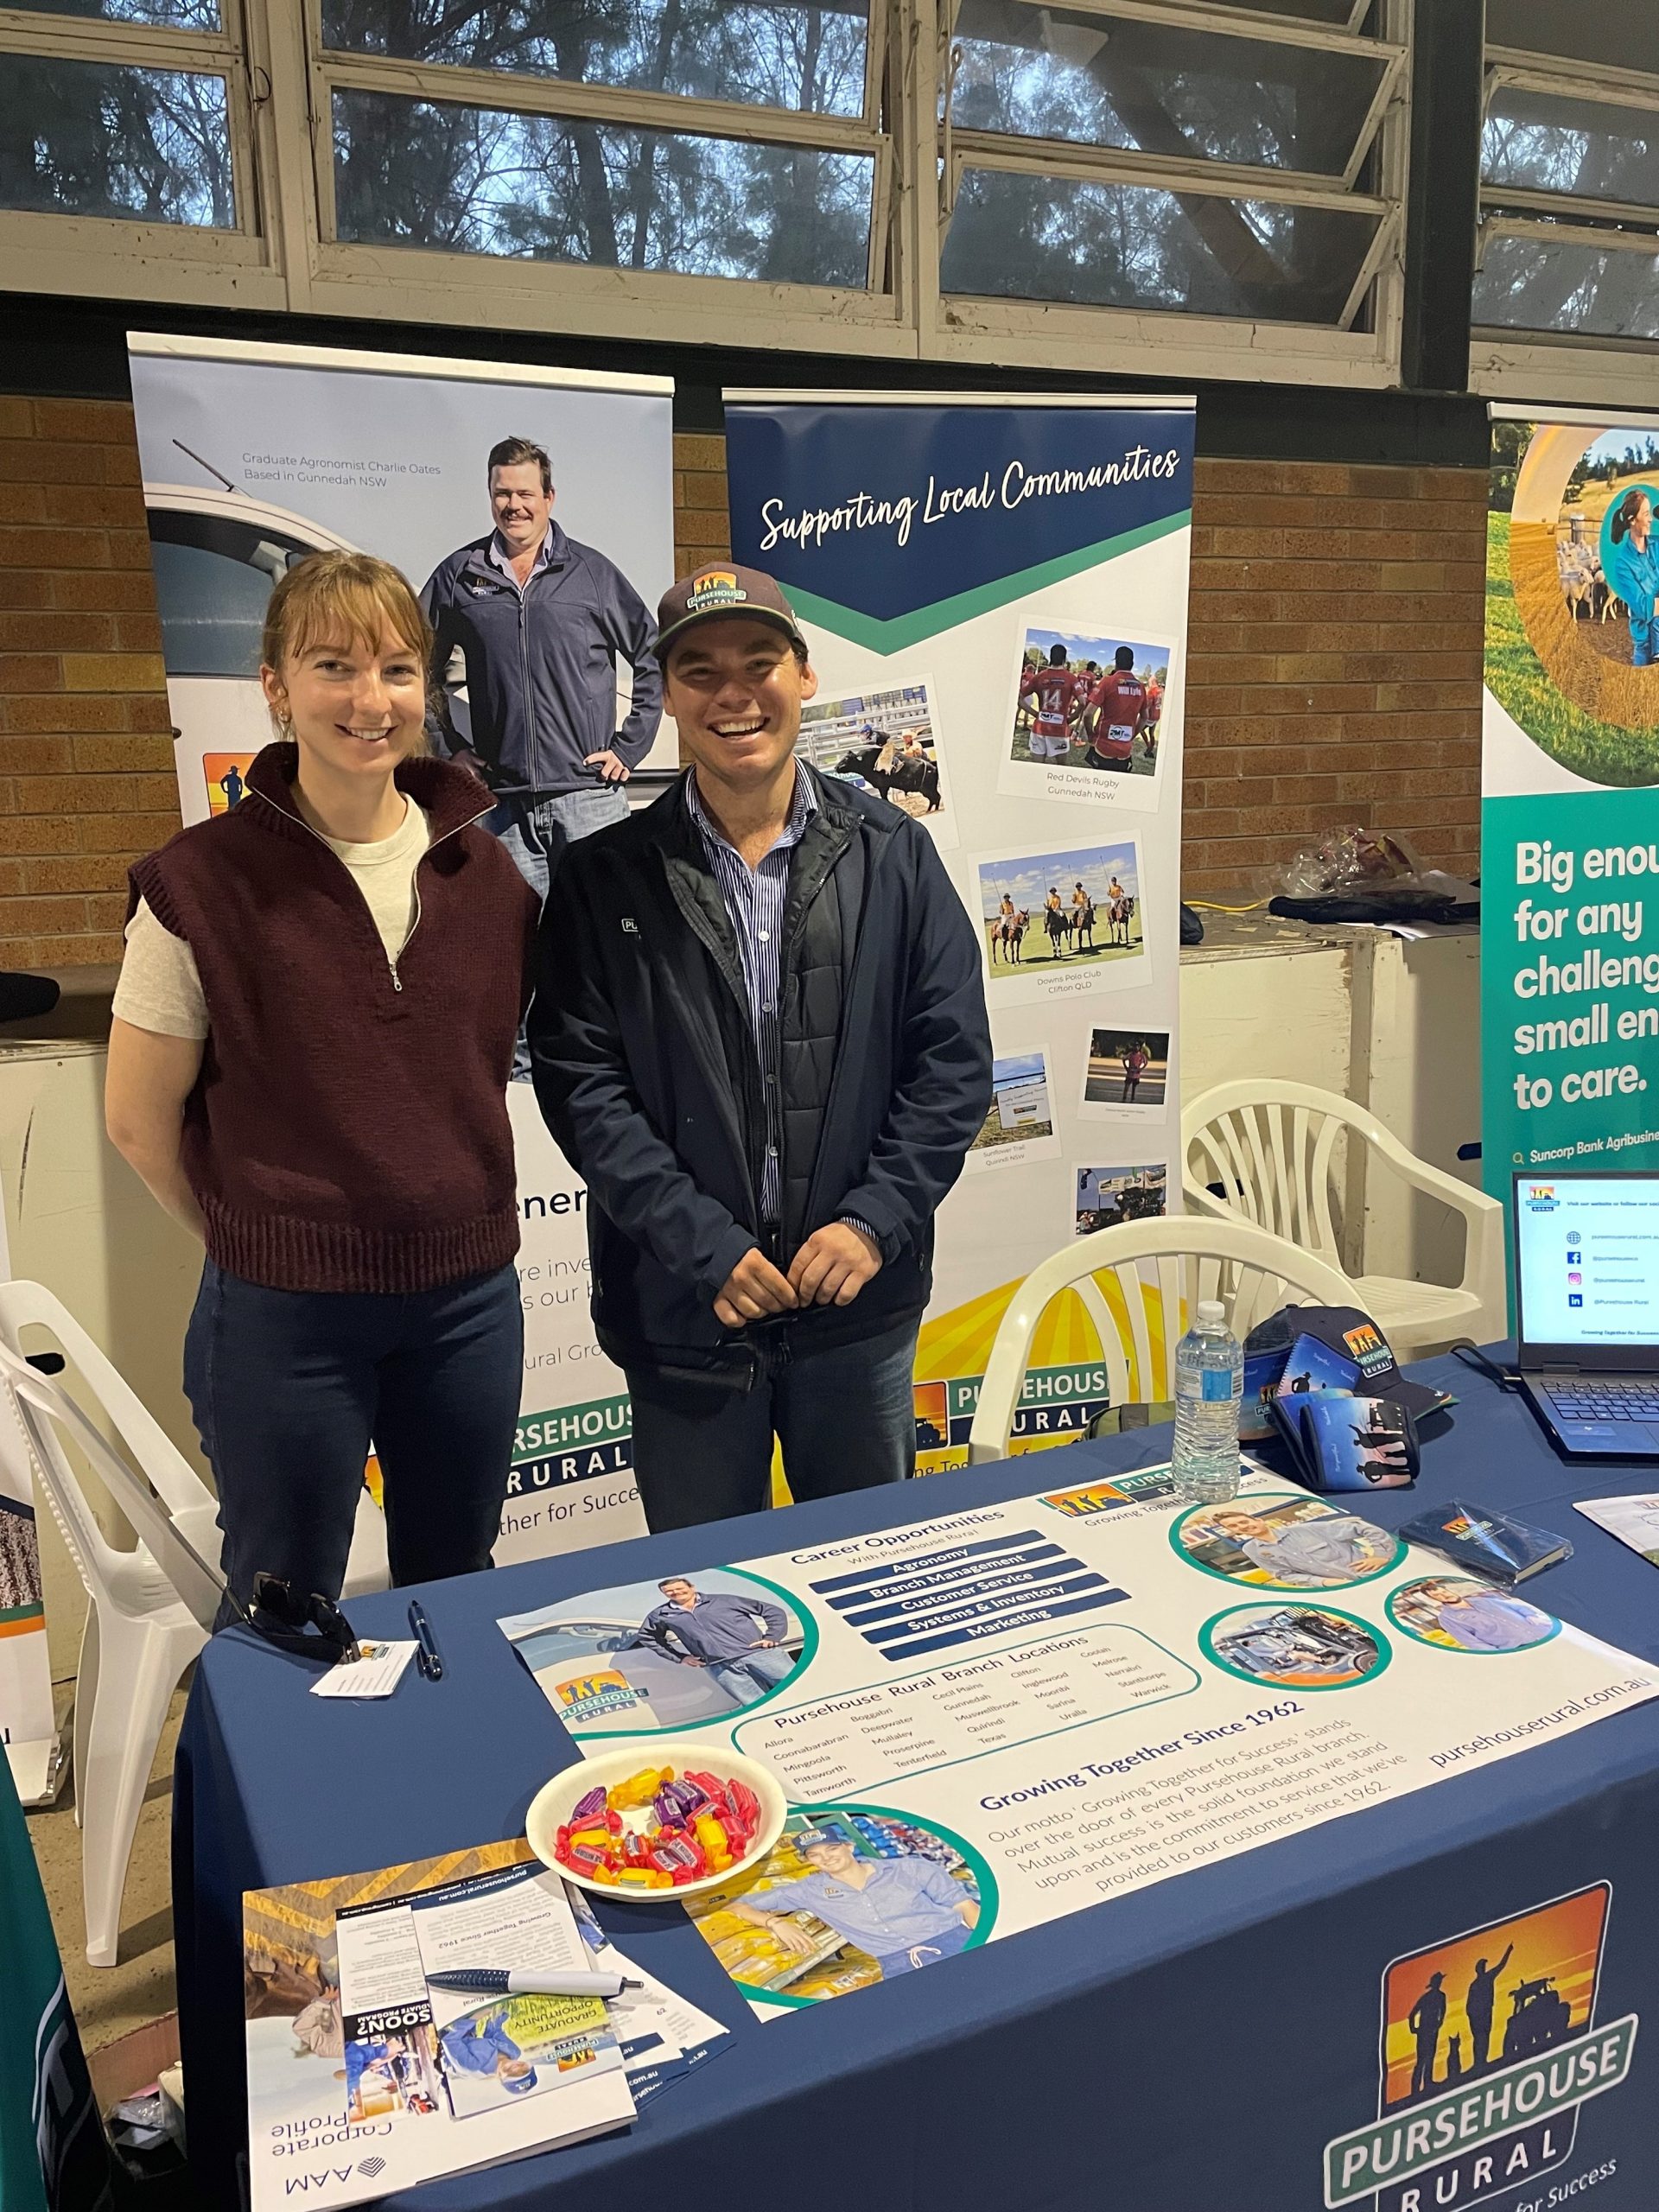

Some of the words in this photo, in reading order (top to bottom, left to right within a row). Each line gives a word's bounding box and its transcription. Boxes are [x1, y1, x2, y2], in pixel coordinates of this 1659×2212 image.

[243, 453, 297, 465] Graduate
[300, 457, 365, 470] Agronomist
[368, 461, 406, 473] Charlie
[410, 464, 441, 474] Oates
[245, 469, 280, 480] Based
[283, 471, 295, 480] in
[297, 472, 356, 485] Gunnedah
[359, 476, 386, 487] NSW
[760, 491, 919, 550] Supporting
[923, 473, 995, 523] Local
[1001, 445, 1179, 511] Communities
[690, 590, 743, 605] PURSEHOUSE
[1042, 689, 1062, 710] 14
[1047, 772, 1064, 781] Red
[1065, 774, 1090, 785] Devils
[1093, 778, 1119, 788] Rugby
[1048, 786, 1092, 798] Gunnedah
[1094, 791, 1116, 800] NSW
[1516, 840, 1573, 893] Big
[1514, 899, 1569, 942] for
[1577, 901, 1643, 942] any
[1048, 985, 1073, 994] Clifton
[1075, 982, 1092, 990] QLD
[1514, 1003, 1609, 1055] small
[1617, 1007, 1659, 1039] en
[1514, 1073, 1553, 1109] to
[1560, 1065, 1647, 1103] care.
[1010, 1154, 1025, 1162] NSW
[1529, 1146, 1574, 1163] Suncorp
[1577, 1139, 1604, 1154] Bank
[541, 1287, 578, 1306] our
[1366, 1361, 1389, 1374] RURAL
[1012, 1407, 1090, 1433] URAL
[506, 1446, 627, 1494] RURAL
[547, 1500, 576, 1522] for
[1084, 1510, 1143, 1528] Growing
[791, 1543, 861, 1565] Career
[864, 1510, 1005, 1549] Opportunities
[847, 1553, 879, 1565] With
[880, 1536, 945, 1559] Pursehouse
[945, 1529, 979, 1541] Rural
[893, 1548, 969, 1574] Agronomy
[869, 1579, 926, 1599] Branch
[926, 1554, 1027, 1585] Management
[900, 1586, 980, 1611] Customer
[977, 1572, 1033, 1591] Service
[907, 1607, 976, 1630] Systems
[976, 1603, 992, 1612] &
[990, 1585, 1065, 1608] Inventory
[966, 1609, 1052, 1637] Marketing
[1080, 1646, 1111, 1658] Coolah
[1092, 1656, 1128, 1668] Melrose
[773, 1692, 882, 1729] Pursehouse
[887, 1676, 937, 1696] Rural
[941, 1659, 1004, 1682] Branch
[1007, 1636, 1089, 1662] Locations
[1011, 1666, 1041, 1679] Clifton
[1021, 1671, 1069, 1689] Inglewood
[1117, 1671, 1166, 1688] Stanthorpe
[932, 1688, 957, 1701] Cecil
[957, 1682, 984, 1694] Plains
[1034, 1684, 1071, 1700] Moonbi
[1130, 1684, 1171, 1699] Warwick
[561, 1688, 647, 1719] PURSEHOUSE
[581, 1701, 633, 1720] RURAL
[944, 1694, 992, 1711] Gunnedah
[955, 1700, 1021, 1722] Muswellbrook
[1046, 1698, 1077, 1711] Sarina
[850, 1707, 893, 1723] Boggabri
[861, 1716, 914, 1734] Deepwater
[1058, 1708, 1088, 1721] Uralla
[1428, 1676, 1653, 1768] pursehouserural.com.au
[967, 1718, 1006, 1733] Quirindi
[765, 1736, 794, 1749] Allora
[773, 1733, 849, 1761] Coonabarabran
[871, 1731, 913, 1745] Mullaley
[882, 1738, 936, 1757] Proserpine
[977, 1732, 1007, 1745] Texas
[783, 1754, 831, 1773] Mingoola
[893, 1749, 947, 1769] Tenterfield
[980, 1772, 1087, 1811] Growing
[1080, 1739, 1184, 1778] Together
[1183, 1721, 1247, 1746] Since
[1245, 1700, 1306, 1726] 1962
[793, 1764, 847, 1785] Pittsworth
[988, 1826, 1021, 1843] Our
[1082, 1786, 1152, 1814] Growing
[1146, 1763, 1216, 1789] Together
[1216, 1754, 1239, 1768] for
[1304, 1718, 1351, 1738] stands
[803, 1777, 857, 1797] Tamworth
[1004, 1840, 1046, 1858] over
[1045, 1829, 1075, 1846] the
[1078, 1815, 1116, 1834] door
[1120, 1808, 1137, 1821] of
[1141, 1793, 1185, 1814] every
[1186, 1764, 1274, 1797] Pursehouse
[1274, 1747, 1314, 1768] Rural
[1313, 1730, 1370, 1753] branch.
[1016, 1847, 1081, 1873] Mutual
[1084, 1825, 1147, 1853] success
[1147, 1820, 1165, 1831] is
[1166, 1807, 1196, 1823] the
[1198, 1793, 1236, 1813] solid
[1236, 1766, 1319, 1799] foundation
[1320, 1757, 1346, 1771] we
[1346, 1741, 1389, 1761] stand
[1035, 1868, 1082, 1889] upon
[1082, 1854, 1116, 1874] and
[1113, 1852, 1131, 1863] is
[1130, 1839, 1161, 1858] the
[1162, 1805, 1263, 1847] commitment
[1262, 1797, 1279, 1811] to
[1282, 1781, 1334, 1804] service
[1331, 1770, 1366, 1789] that
[1366, 1753, 1408, 1771] we've
[1095, 1857, 1170, 1892] provided
[1168, 1851, 1191, 1866] to
[1192, 1840, 1219, 1856] our
[1223, 1811, 1305, 1845] customers
[1304, 1797, 1346, 1818] since
[1344, 1780, 1392, 1803] 1962.
[518, 1911, 551, 1926] Growing
[460, 1932, 482, 1943] Since
[483, 1924, 518, 1937] Together
[438, 1938, 459, 1948] 1962
[462, 1994, 485, 2007] Rural
[357, 2009, 431, 2035] SOON?
[358, 2010, 391, 2024] PROGRAM
[515, 1999, 594, 2031] OPPORTUNITY
[537, 2010, 598, 2034] GRADUATE
[548, 2038, 600, 2060] PURSEHOUSE
[1341, 2034, 1621, 2189] PURSEHOUSE
[271, 2112, 347, 2139] Profile
[286, 2164, 353, 2195] AAM
[1401, 2129, 1557, 2212] RURAL
[1547, 2158, 1618, 2209] Success
